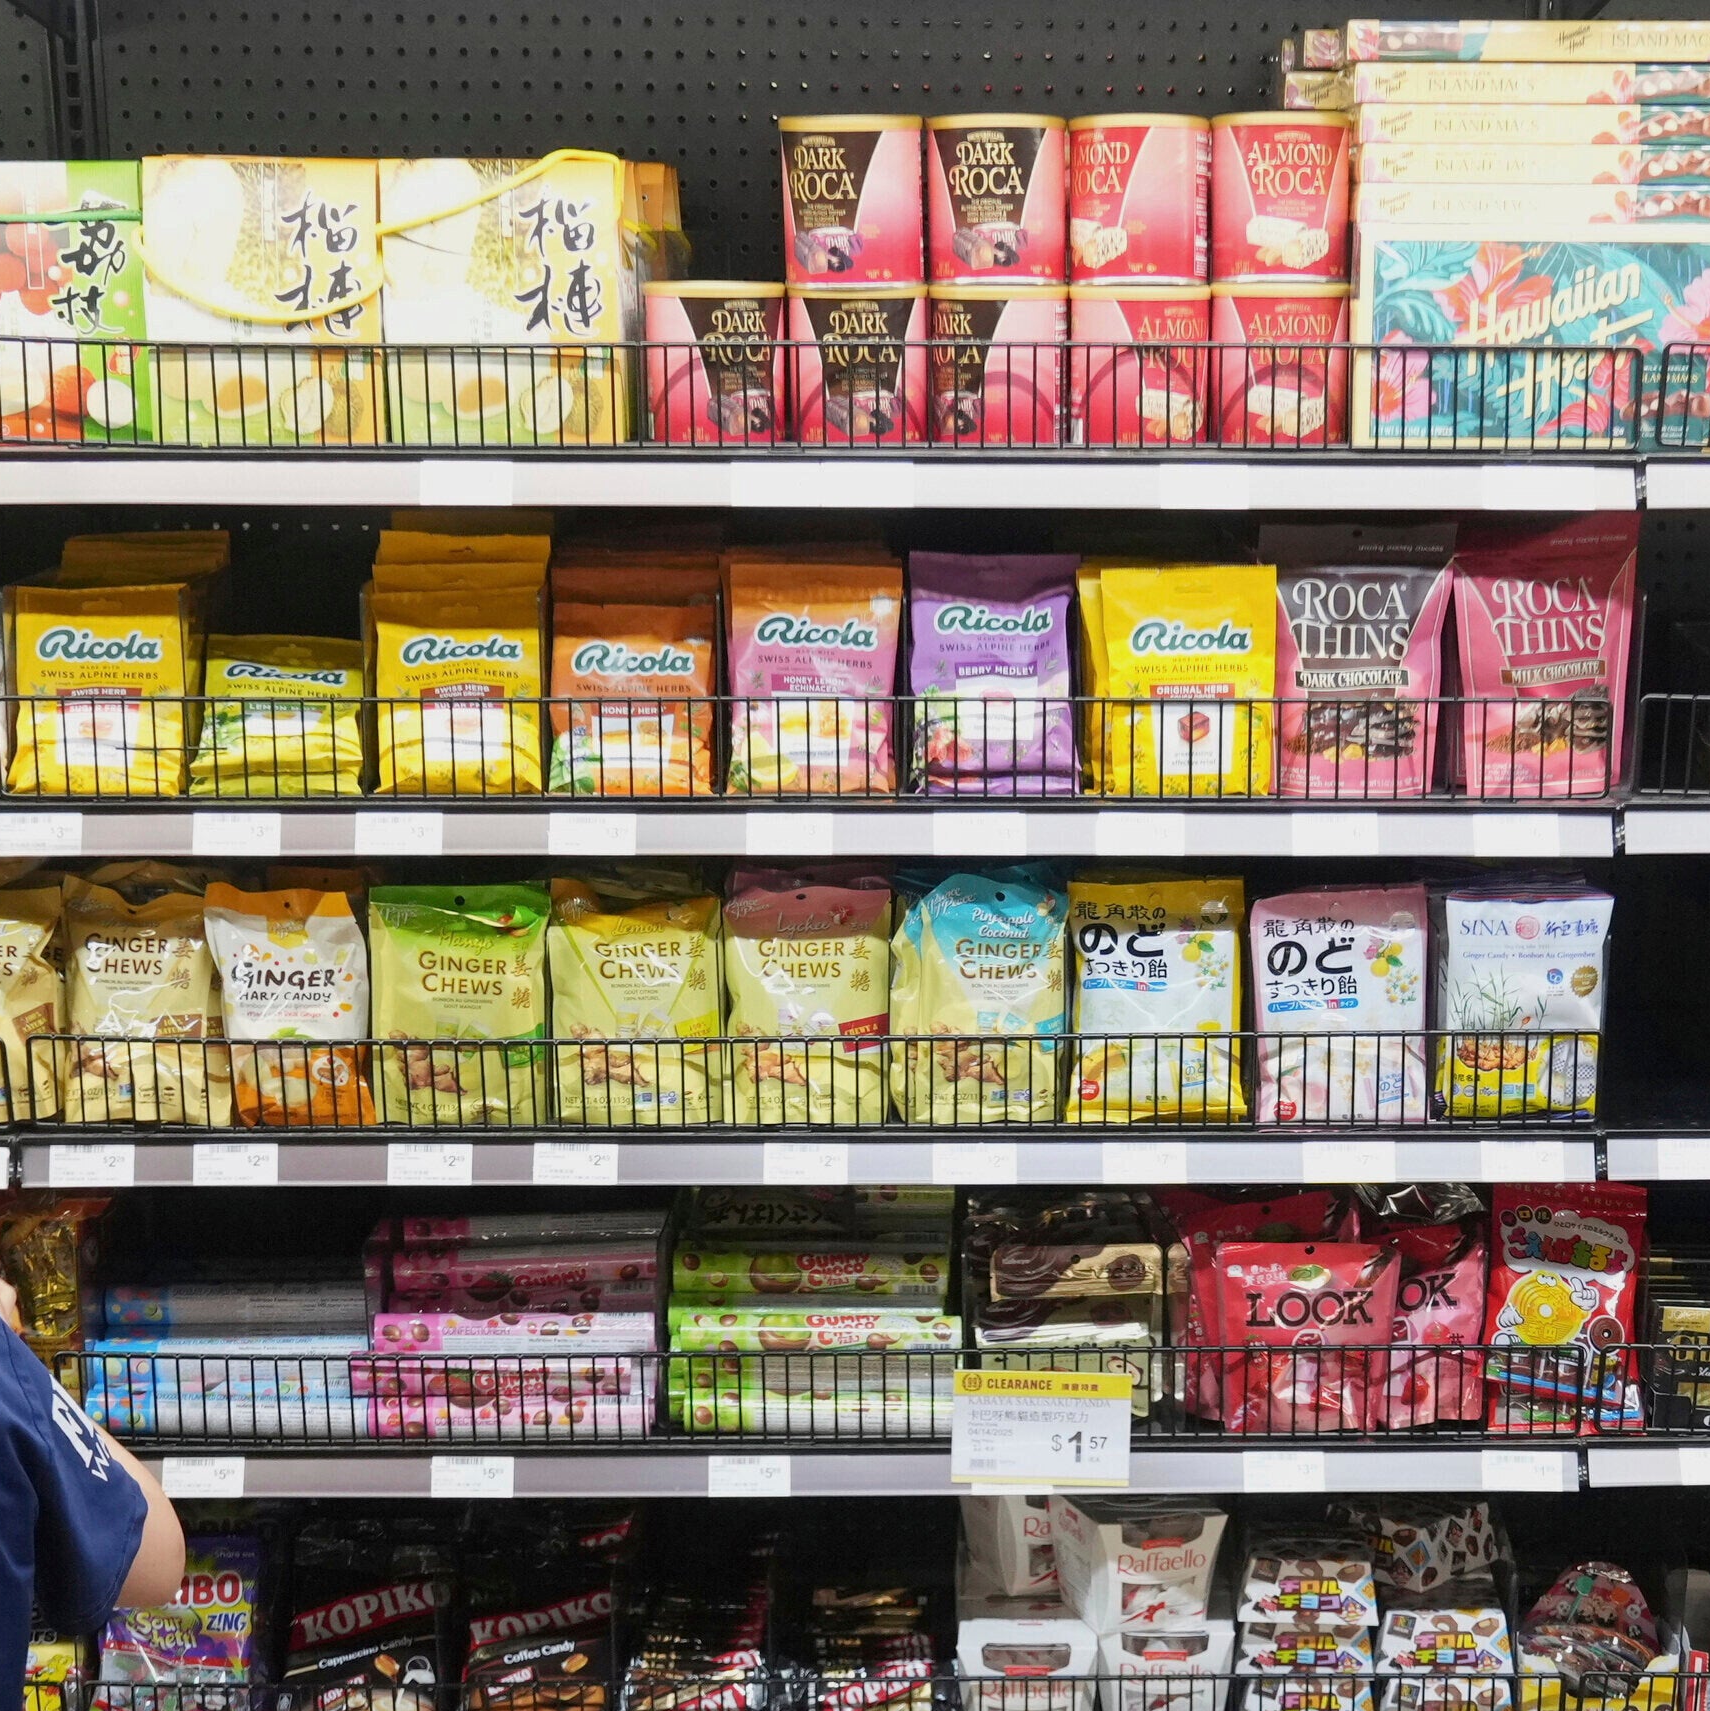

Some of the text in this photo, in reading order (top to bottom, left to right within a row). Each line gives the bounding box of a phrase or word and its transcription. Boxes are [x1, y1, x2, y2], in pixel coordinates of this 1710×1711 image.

[794, 146, 846, 170] DARK
[954, 141, 1015, 165] DARK
[1248, 141, 1332, 166] ALMOND
[791, 171, 855, 200] ROCA
[949, 165, 1023, 197] ROCA
[1252, 166, 1325, 197] ROCA
[1466, 262, 1642, 371] Hawaiian
[1292, 579, 1407, 622] ROCA
[1491, 577, 1592, 618] ROCA
[936, 604, 1052, 634] Ricola
[39, 630, 160, 661] Ricola
[1132, 621, 1251, 652] Ricola
[1289, 622, 1411, 661] THINS
[1490, 615, 1606, 657] THINS
[402, 634, 521, 666] Ricola
[575, 645, 694, 674] Ricola
[958, 664, 1034, 676] BERRY MEDLEY
[1134, 663, 1249, 674] SWISS ALPINE HERBS
[1301, 668, 1403, 688] DARK CHOCOLATE
[1511, 660, 1600, 685] MILK CHOCOLATE
[1156, 684, 1230, 696] ORIGINAL HERB
[1075, 902, 1167, 922] 龍角散の
[978, 925, 1030, 940] Coconut
[1078, 923, 1166, 958] のど
[1460, 919, 1509, 937] SINA
[418, 950, 507, 975] GINGER
[595, 941, 681, 960] GINGER
[1267, 939, 1355, 976] のど
[231, 962, 336, 990] GINGER
[599, 959, 680, 980] CHEWS
[1085, 958, 1168, 980] すっきり飴
[283, 991, 332, 1003] CANDY
[421, 974, 503, 997] CHEWS
[1265, 976, 1358, 999] すっきり飴
[1246, 1290, 1374, 1330] LOOK
[986, 1378, 1053, 1392] CLEARANCE
[1117, 1550, 1207, 1576] Raffaello
[1279, 1576, 1341, 1595] チロル
[300, 1580, 449, 1644] KOPIKO
[318, 1641, 377, 1670] Cappuccino
[504, 1640, 575, 1665] Coffee Candy
